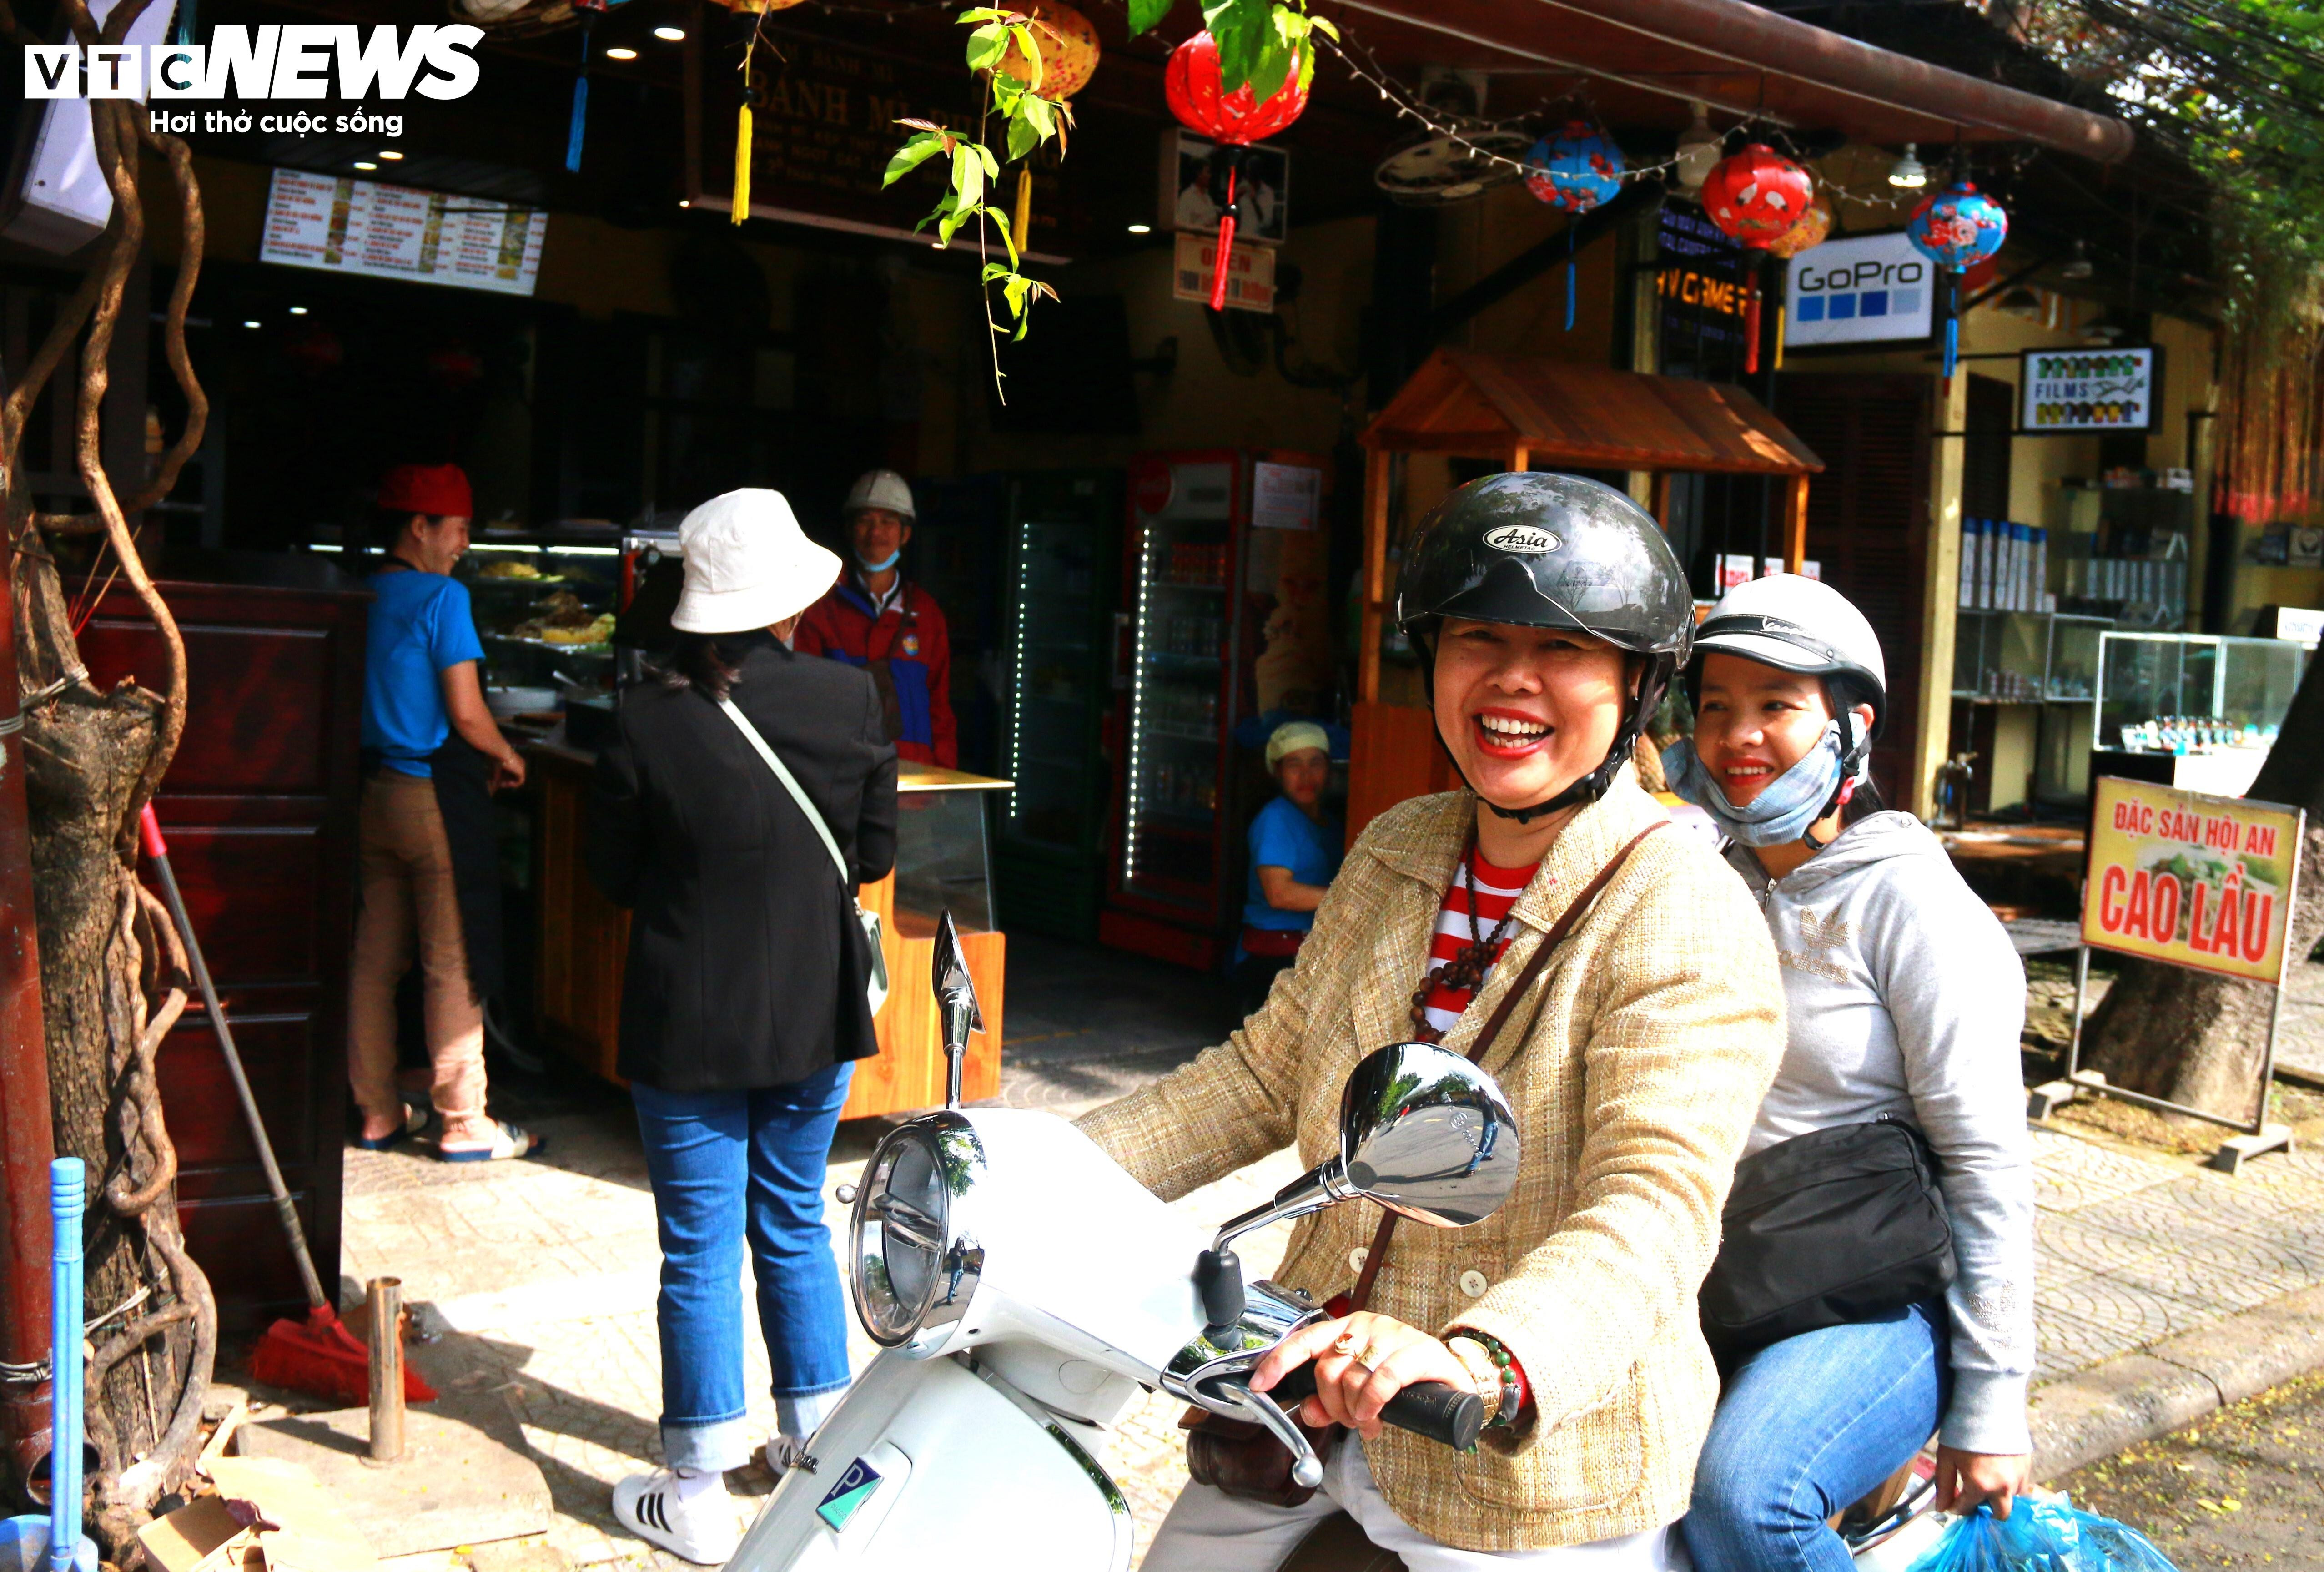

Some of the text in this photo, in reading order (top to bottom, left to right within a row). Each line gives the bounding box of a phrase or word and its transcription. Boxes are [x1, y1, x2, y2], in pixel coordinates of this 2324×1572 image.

[1201, 247, 1251, 272] OEN
[1798, 260, 1923, 292] GoPro
[2035, 382, 2088, 398] FILMS
[1494, 529, 1548, 548] Asia
[2113, 798, 2278, 857] ĐẶC SẢN HỘI AN
[2100, 863, 2275, 963] CAO LẦU
[830, 1463, 864, 1497] P
[830, 1503, 848, 1520] PIAGGIO
